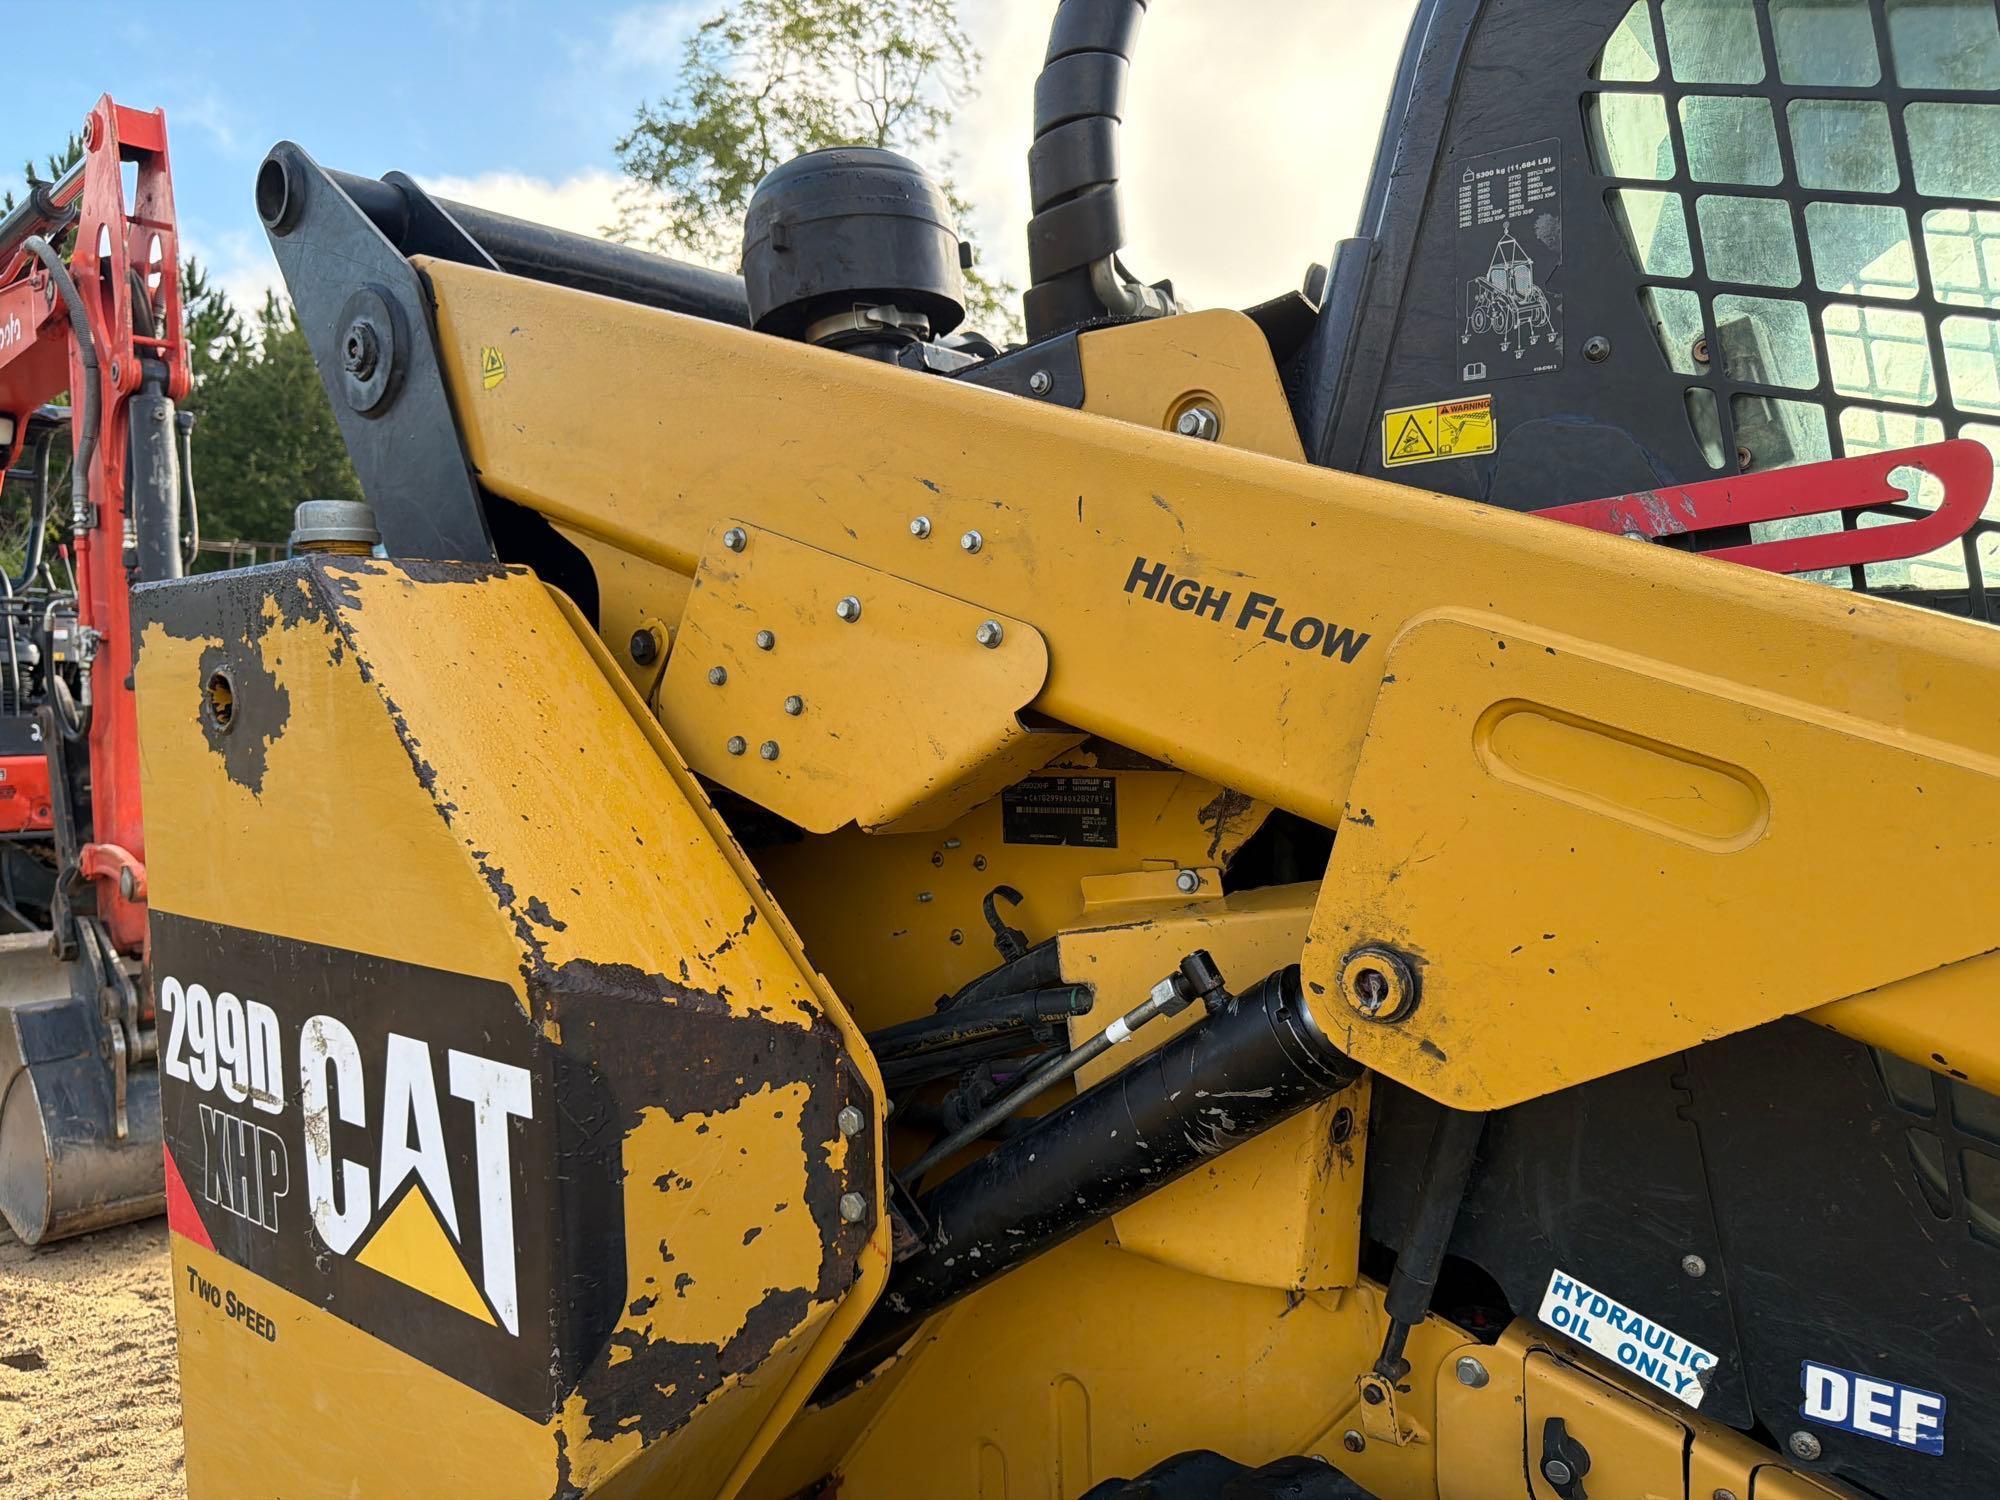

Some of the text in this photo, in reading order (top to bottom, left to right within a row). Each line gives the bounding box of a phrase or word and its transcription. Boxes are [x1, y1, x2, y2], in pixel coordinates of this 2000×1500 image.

[1475, 169, 1494, 179] 5300
[1496, 167, 1505, 175] kg
[1450, 400, 1490, 413] WARNING
[1123, 556, 1371, 664] HIGH FLOW
[161, 975, 533, 1338] 299D CAT
[199, 1103, 289, 1234] XHP
[186, 1265, 276, 1342] TWO SPEED
[1551, 1274, 1711, 1374] HYDRAULIC
[1551, 1306, 1693, 1396] OIL ONLY
[1804, 1365, 1942, 1445] DEF
